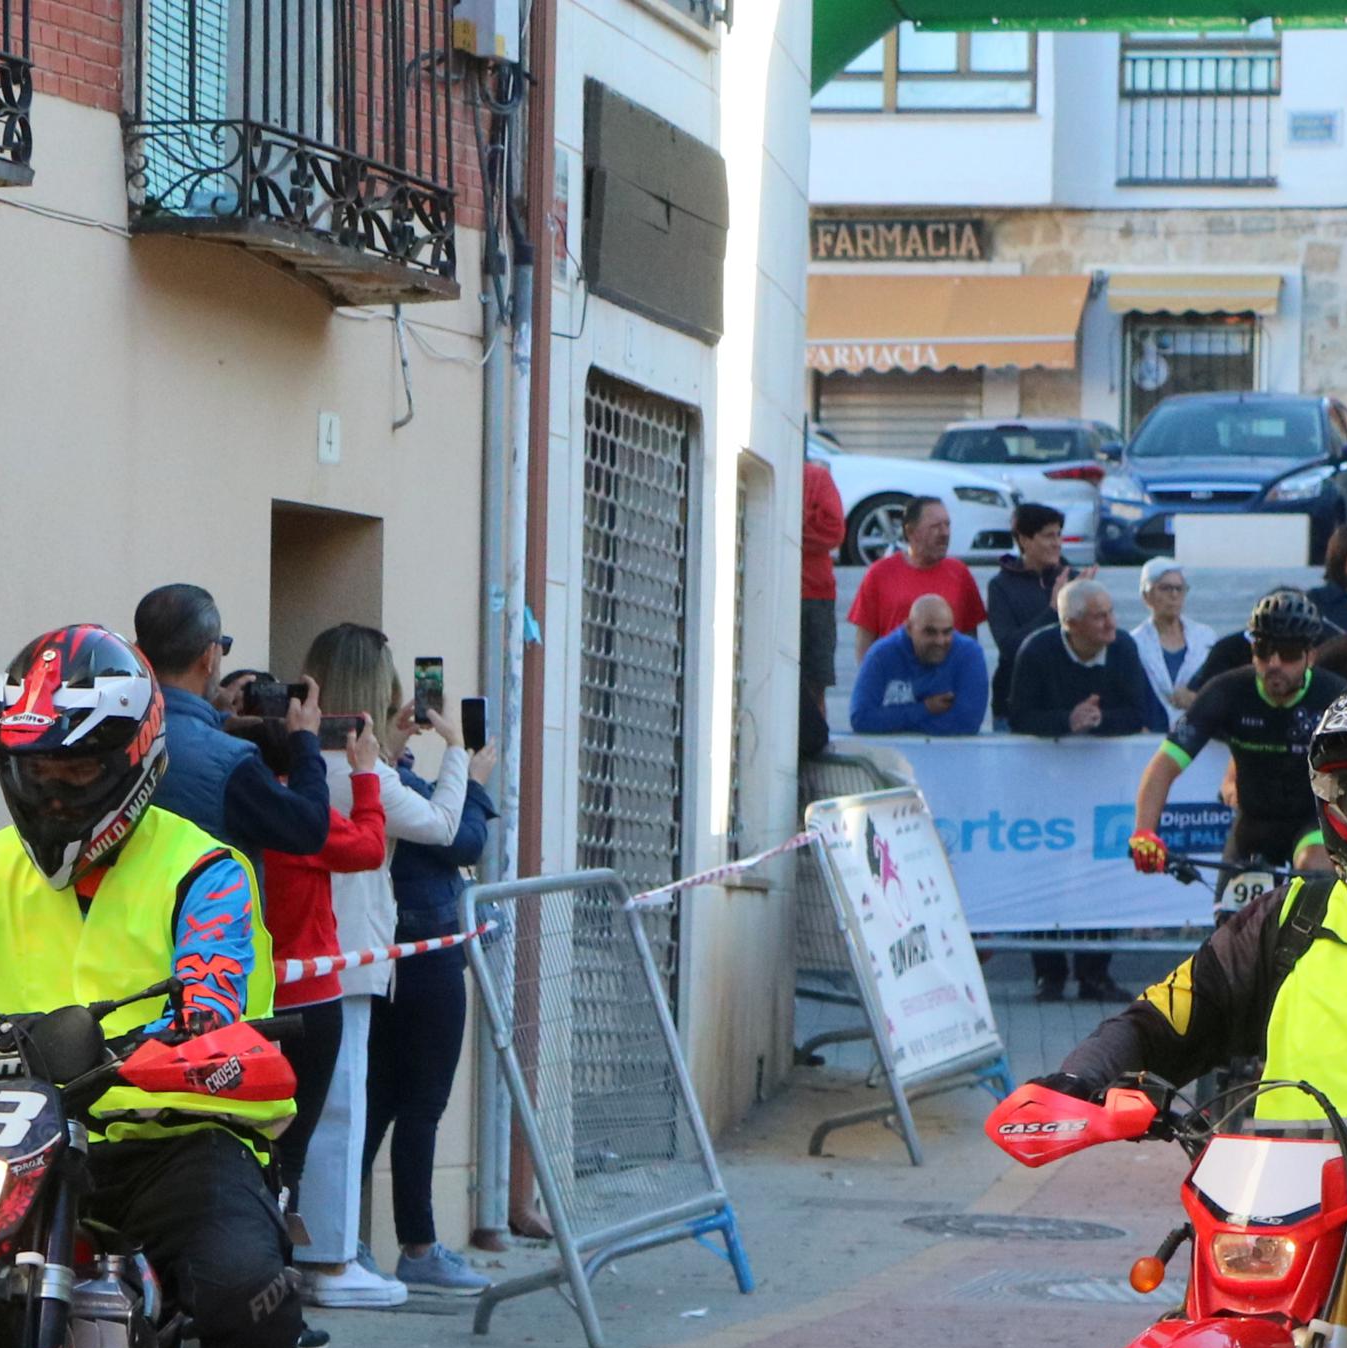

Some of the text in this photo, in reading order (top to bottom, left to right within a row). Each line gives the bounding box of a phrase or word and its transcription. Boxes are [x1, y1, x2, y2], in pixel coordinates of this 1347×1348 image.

[816, 223, 981, 257] FARMACIA
[1161, 811, 1235, 829] Diputac
[86, 823, 127, 865] WILD
[1190, 830, 1234, 846] PAL
[1233, 883, 1265, 904] 98
[204, 1054, 242, 1095] CROSS
